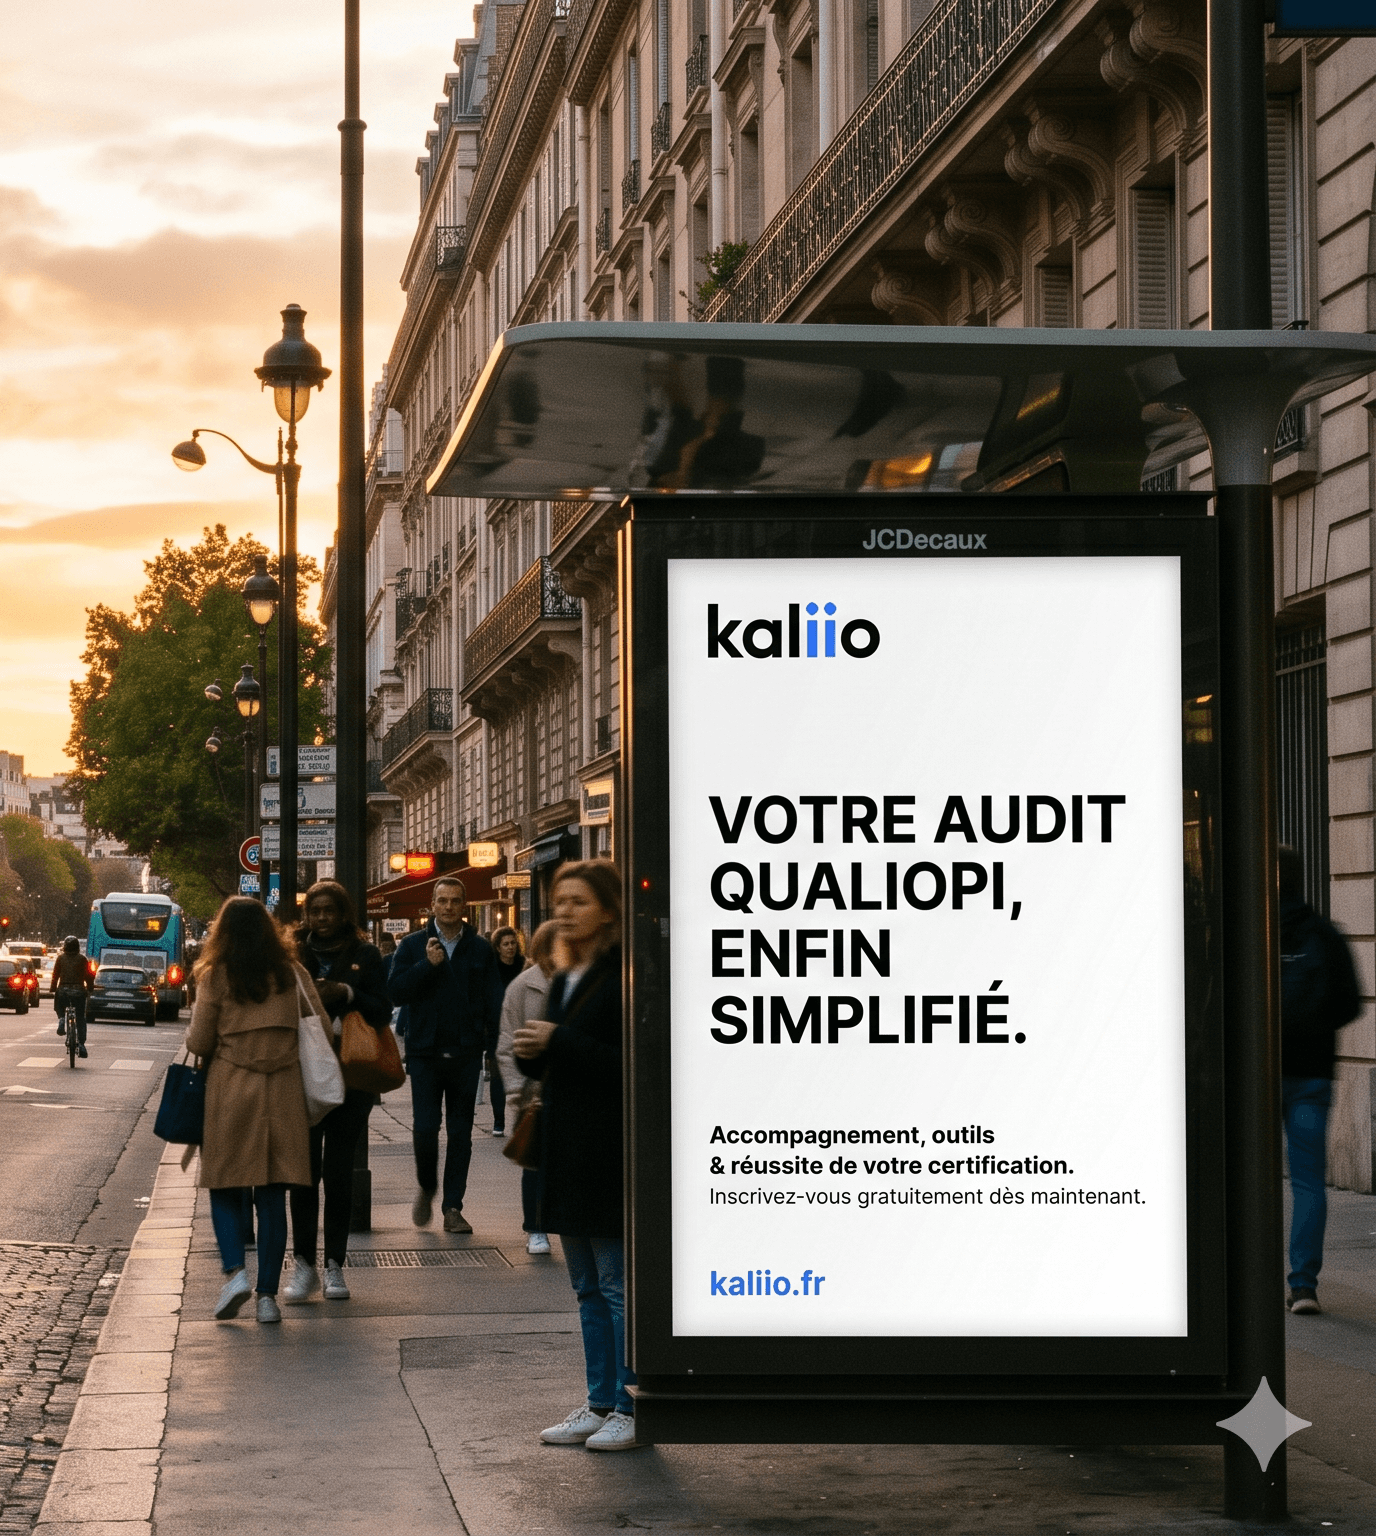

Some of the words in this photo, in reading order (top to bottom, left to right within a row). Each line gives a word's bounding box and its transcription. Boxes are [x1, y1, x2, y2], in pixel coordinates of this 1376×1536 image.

[862, 528, 988, 550] JCDecaux
[707, 601, 881, 659] kaliio
[708, 794, 916, 845] VOTRE
[933, 794, 1127, 844] AUDIT
[710, 861, 1022, 921] QUALIOPI,
[711, 928, 891, 978] ENFIN
[710, 979, 1027, 1045] SIMPLIFIÉ.
[709, 1125, 926, 1149] Accompagnement,
[931, 1124, 995, 1144] outils
[709, 1155, 726, 1175] &
[731, 1154, 824, 1175] réussite
[829, 1155, 858, 1175] de
[862, 1157, 923, 1175] votre
[927, 1154, 1074, 1175] certification.
[710, 1187, 852, 1205] Inscrivez-vous
[857, 1187, 984, 1209] gratuitement
[989, 1186, 1025, 1205] dès
[1031, 1187, 1146, 1205] maintenant.
[710, 1269, 826, 1296] kaliio.fr
